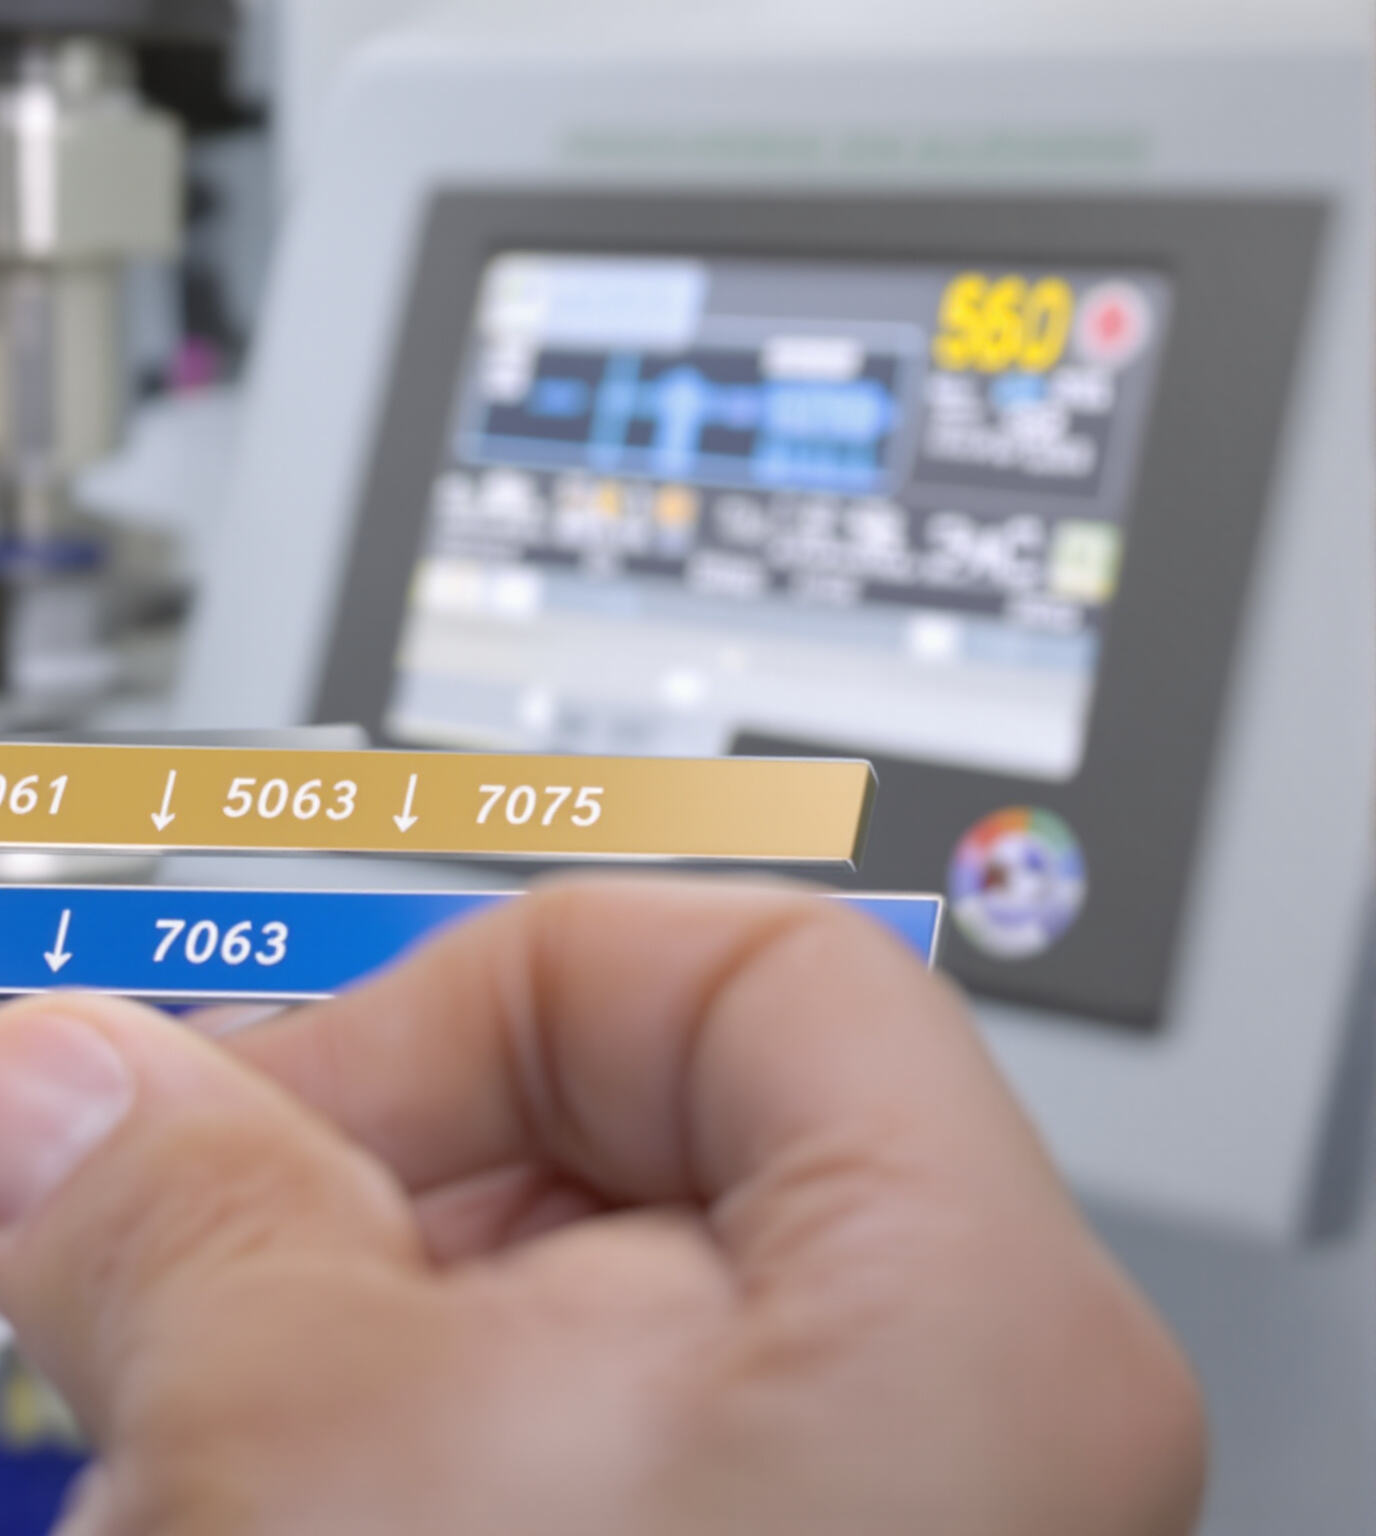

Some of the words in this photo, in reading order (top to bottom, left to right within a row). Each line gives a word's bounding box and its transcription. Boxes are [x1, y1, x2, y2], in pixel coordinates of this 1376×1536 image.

[222, 776, 358, 822] 5063
[475, 783, 605, 828] 7075
[152, 918, 289, 966] 7063
